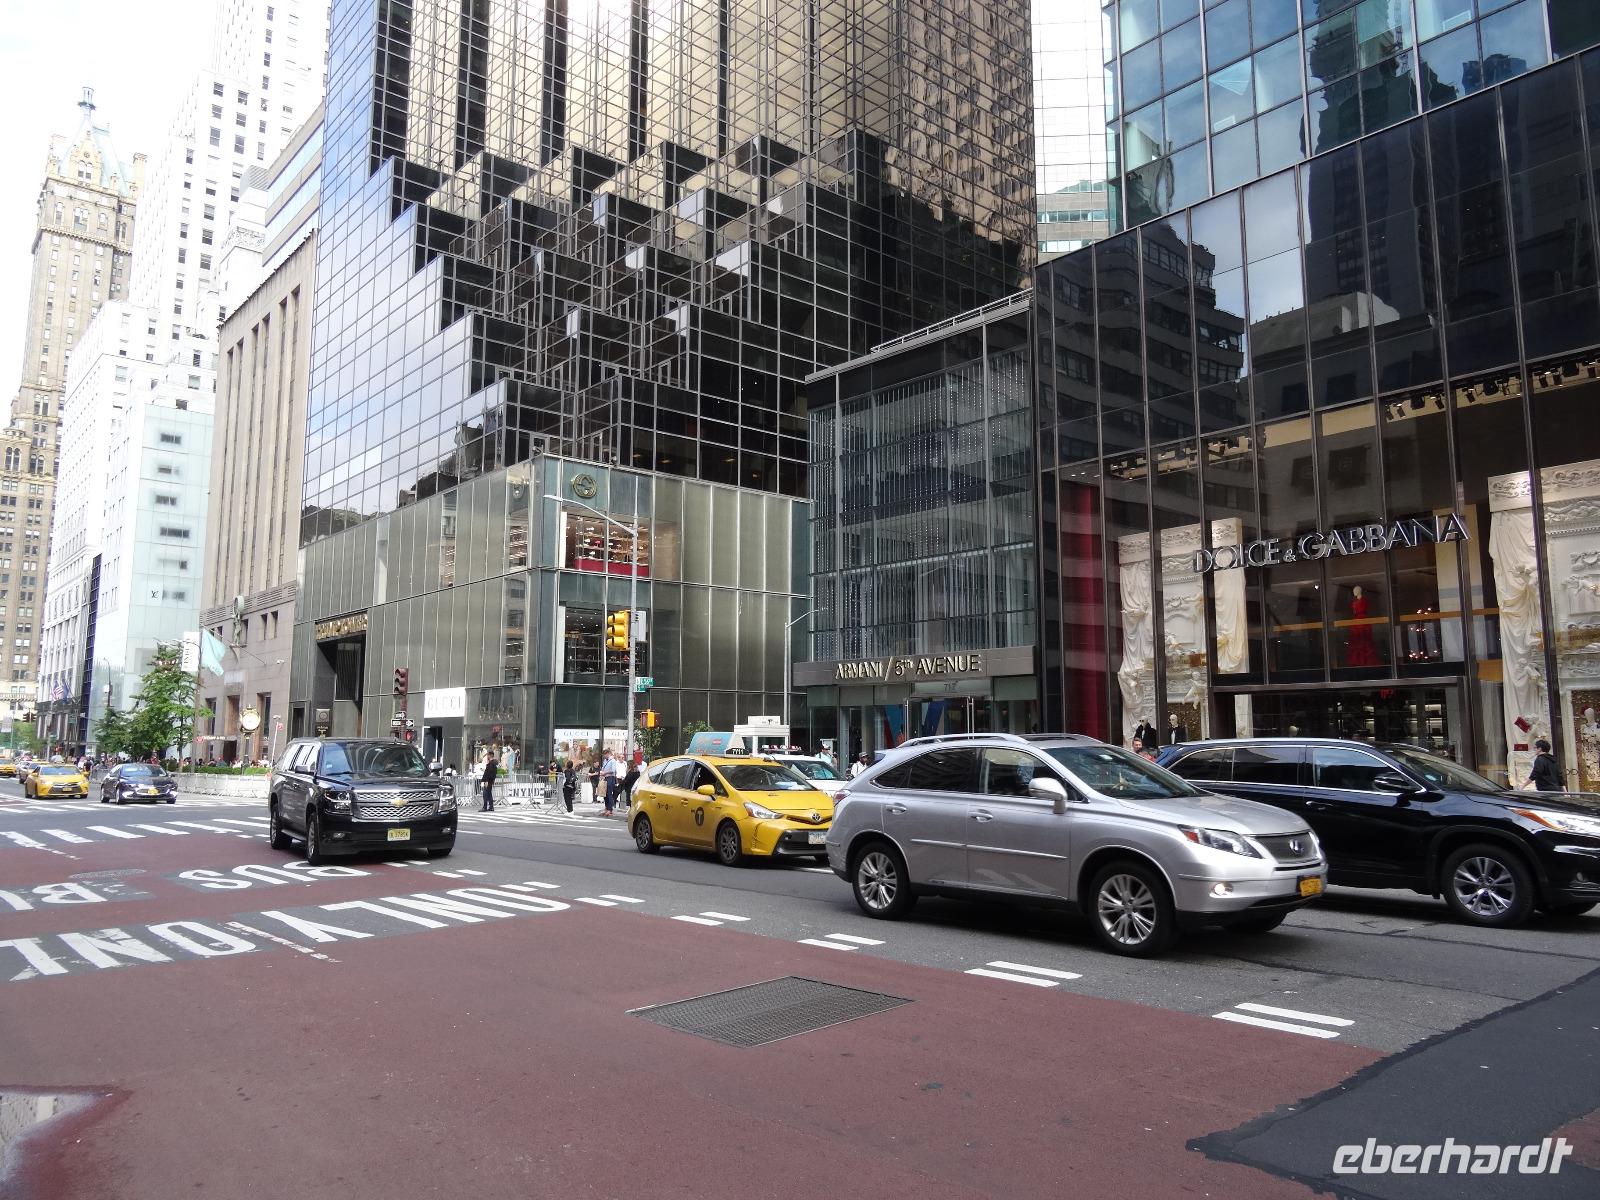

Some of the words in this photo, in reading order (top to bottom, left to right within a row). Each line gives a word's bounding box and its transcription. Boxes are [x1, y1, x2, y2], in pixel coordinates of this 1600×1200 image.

[1193, 538, 1280, 573] DOLCE
[1282, 548, 1297, 562] &
[1298, 512, 1470, 560] GABBANA
[835, 661, 884, 680] ARMANI
[895, 658, 914, 677] 5th
[915, 654, 982, 676] AVENUE
[261, 886, 572, 944] ONLY
